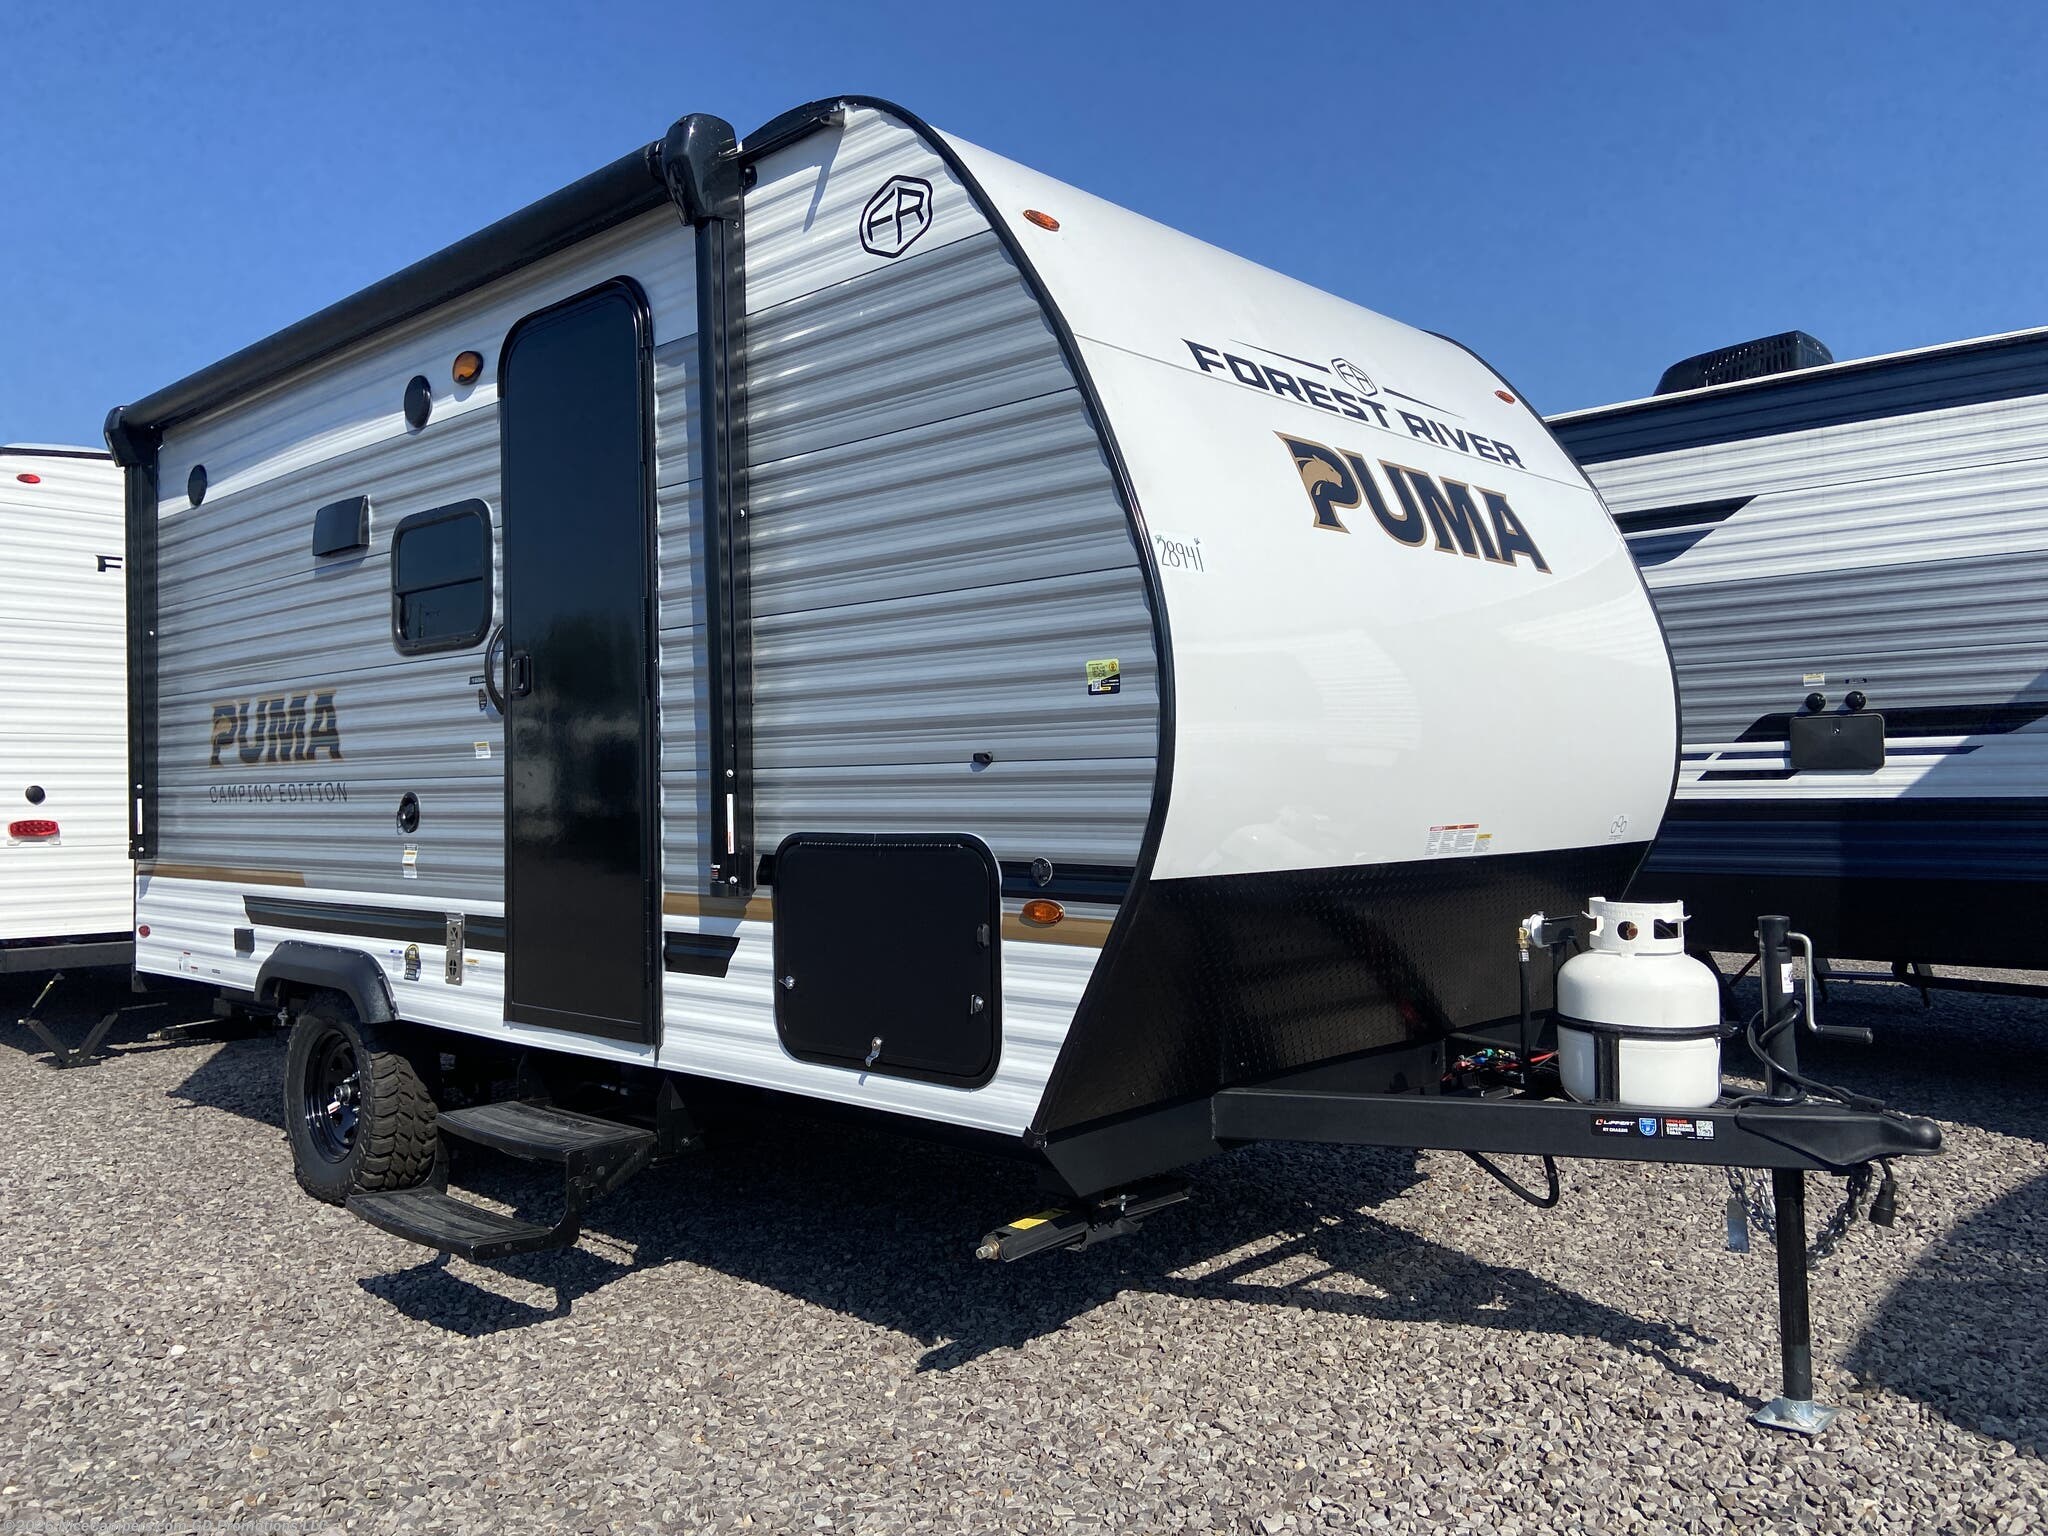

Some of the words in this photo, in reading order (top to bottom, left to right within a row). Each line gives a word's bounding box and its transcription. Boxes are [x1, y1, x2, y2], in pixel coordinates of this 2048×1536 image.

[1181, 337, 1390, 429] FOREST
[1395, 408, 1527, 470] RIVER
[1273, 430, 1552, 574] PUMA
[1158, 538, 1204, 573] 28941
[209, 689, 345, 768] PUMA
[209, 784, 273, 803] CAMPING
[278, 781, 348, 803] EDITION
